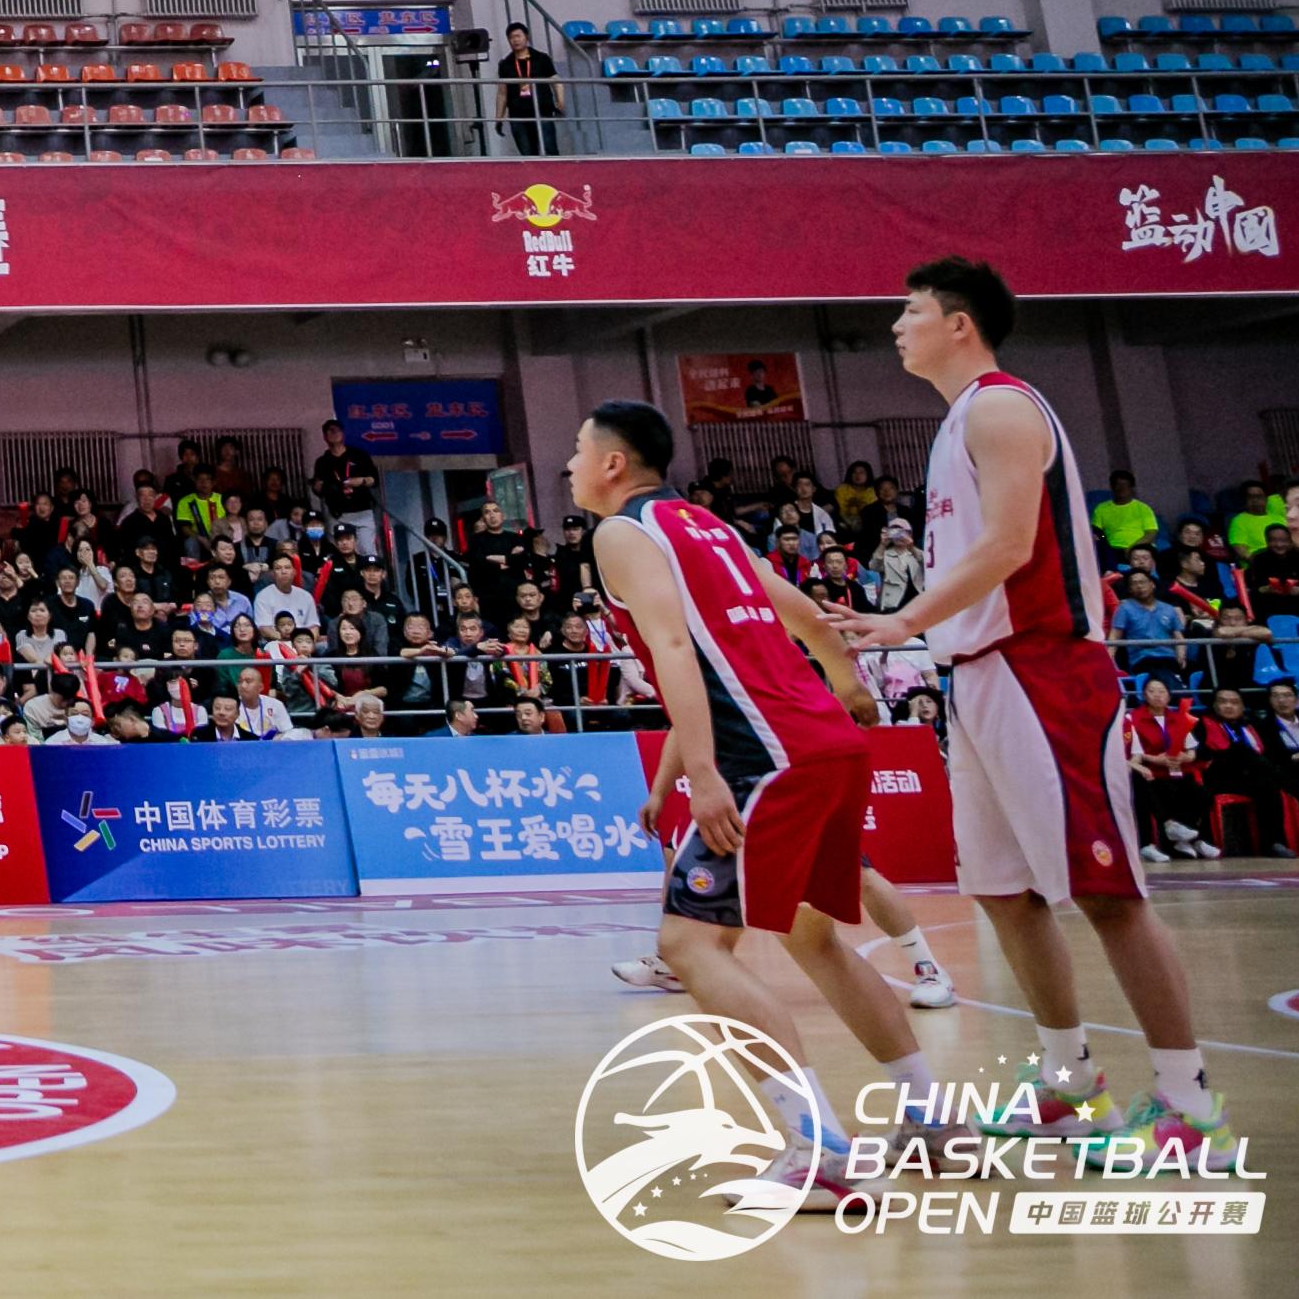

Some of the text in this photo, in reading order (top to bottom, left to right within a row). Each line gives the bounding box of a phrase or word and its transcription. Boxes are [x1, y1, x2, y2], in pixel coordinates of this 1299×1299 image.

[526, 254, 575, 277] 红牛
[712, 545, 753, 596] 1
[362, 767, 574, 813] 每天八杯水
[134, 798, 323, 833] 中国体育彩票
[139, 834, 326, 852] CHINA SPORTS LOTTERY
[430, 813, 649, 861] 雪王爱喝水
